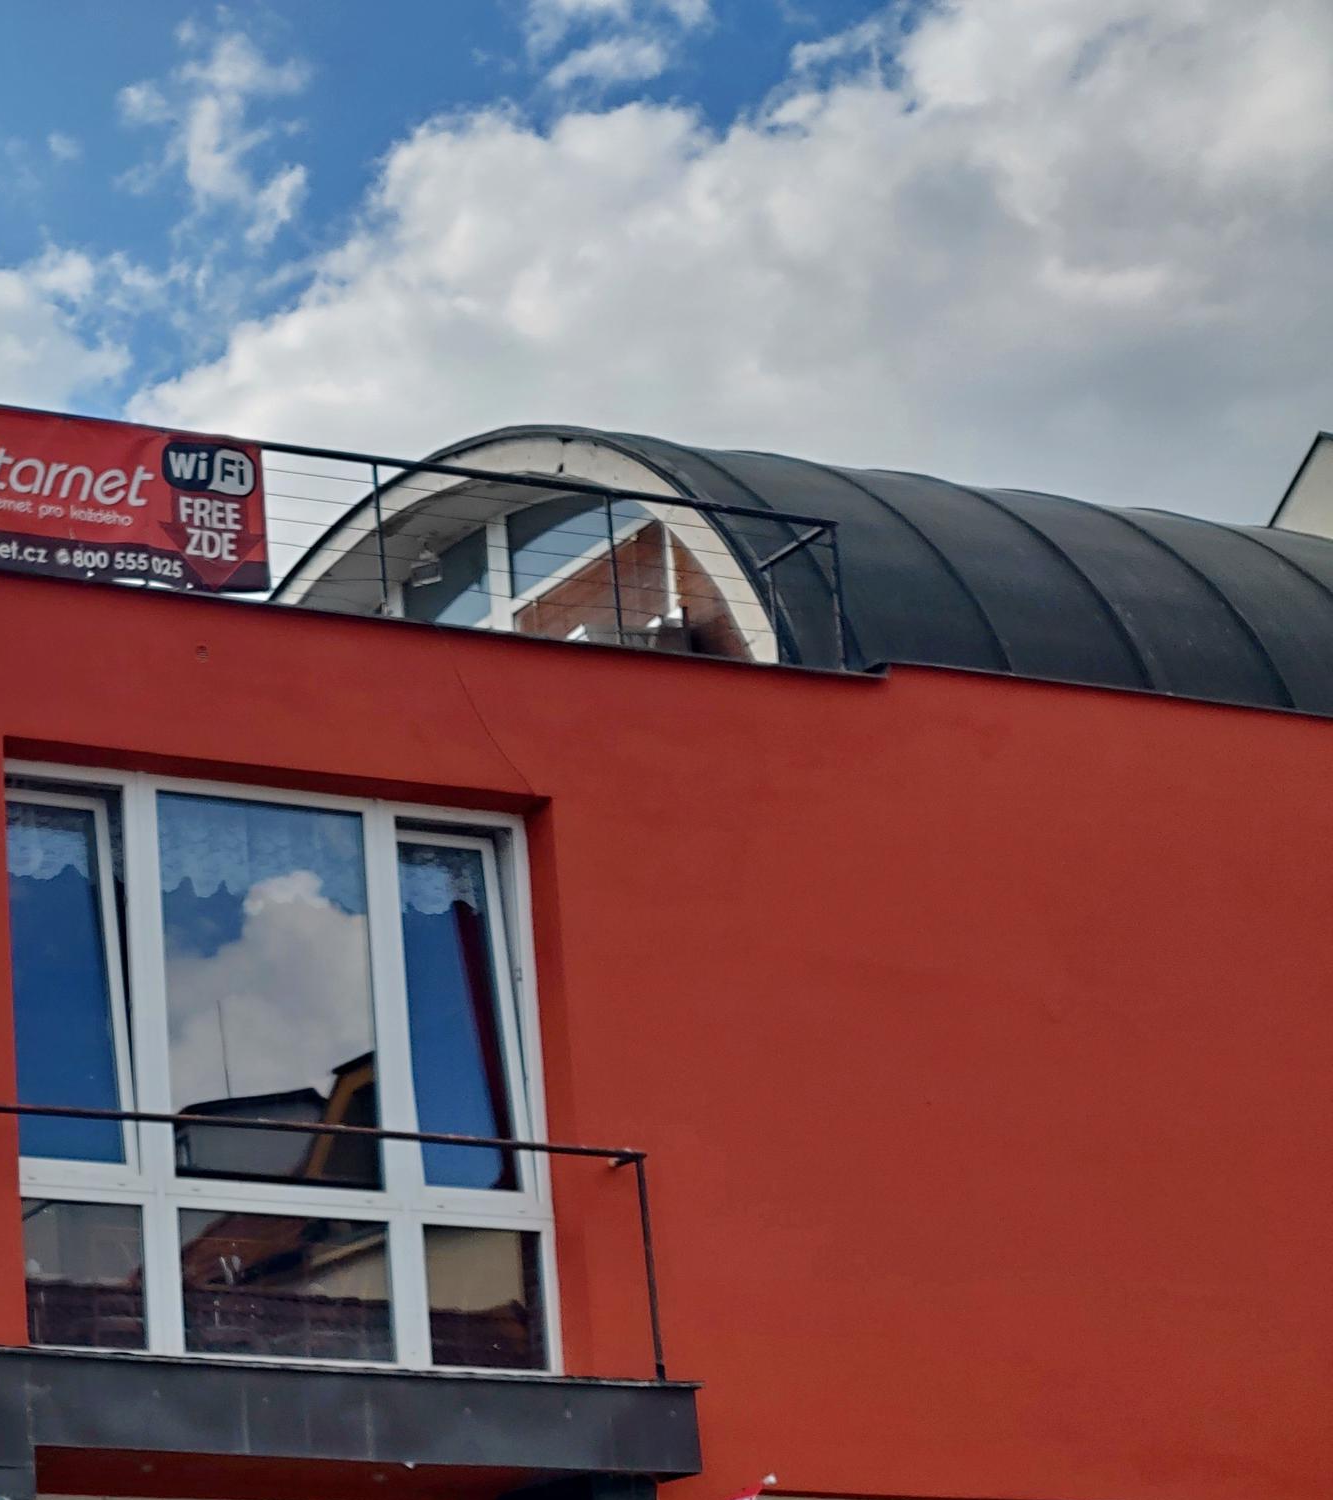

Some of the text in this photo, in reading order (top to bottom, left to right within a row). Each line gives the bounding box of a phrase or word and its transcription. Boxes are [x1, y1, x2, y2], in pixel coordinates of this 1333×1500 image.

[38, 505, 64, 519] pro
[179, 495, 243, 530] FREE
[185, 527, 239, 561] ZDE
[73, 550, 109, 569] 800
[114, 550, 149, 571] 555
[151, 557, 183, 578] 025
